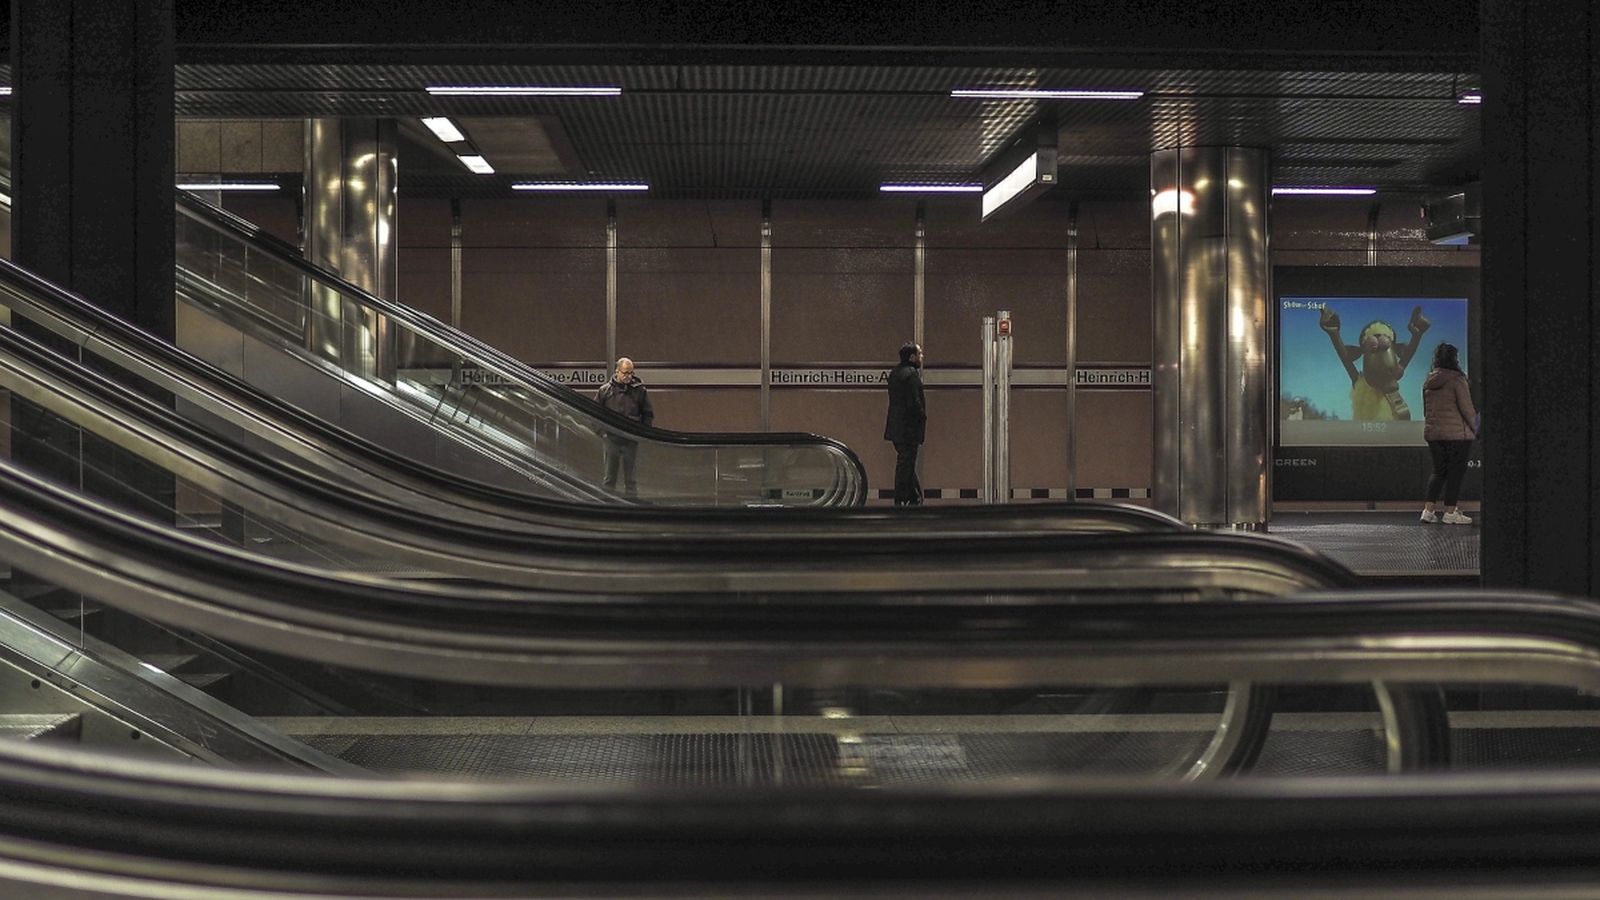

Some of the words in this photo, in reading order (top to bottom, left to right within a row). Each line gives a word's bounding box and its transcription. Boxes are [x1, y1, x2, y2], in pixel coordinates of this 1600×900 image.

[772, 370, 891, 383] Heinrich-Heine-A
[1077, 371, 1150, 383] Heinrich-H
[1274, 458, 1317, 466] CREEN
